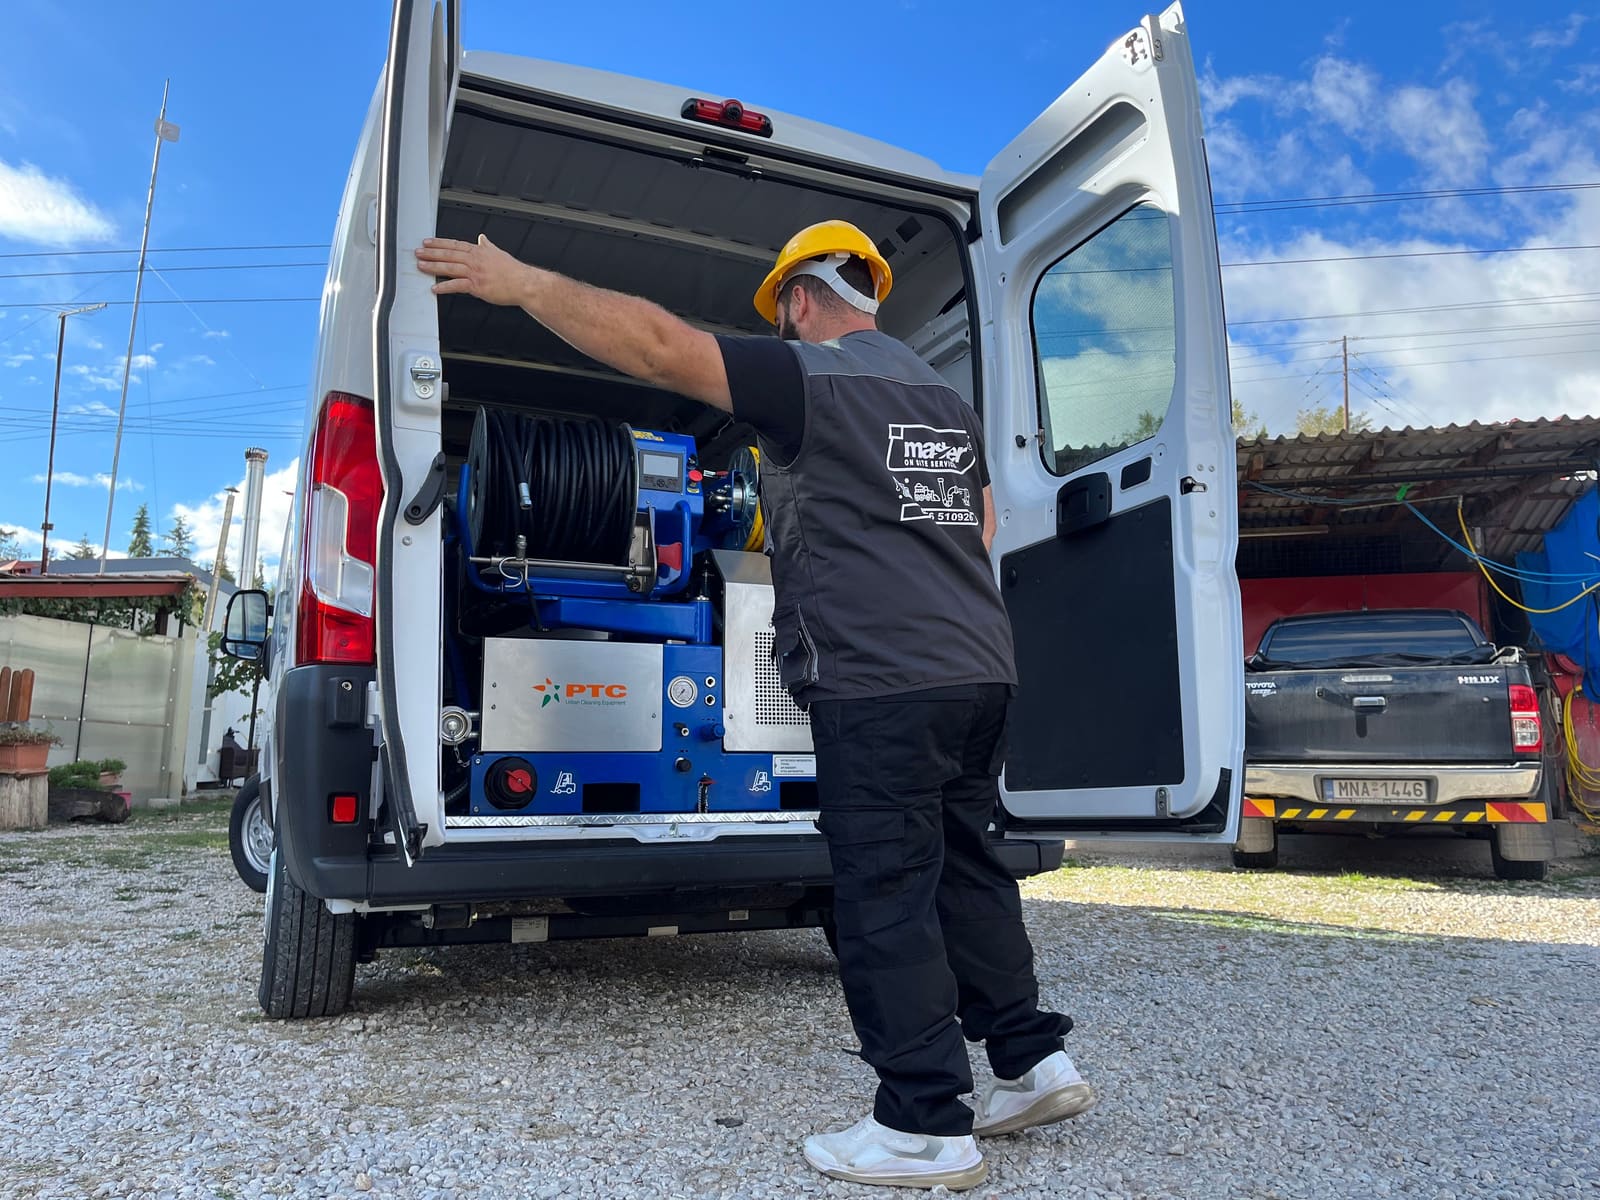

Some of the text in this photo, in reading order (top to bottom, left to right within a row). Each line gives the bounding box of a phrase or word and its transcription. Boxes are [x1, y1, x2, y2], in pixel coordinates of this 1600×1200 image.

[1457, 675, 1500, 684] HILUX
[1246, 681, 1276, 689] TOYOTA
[566, 684, 627, 698] PTC
